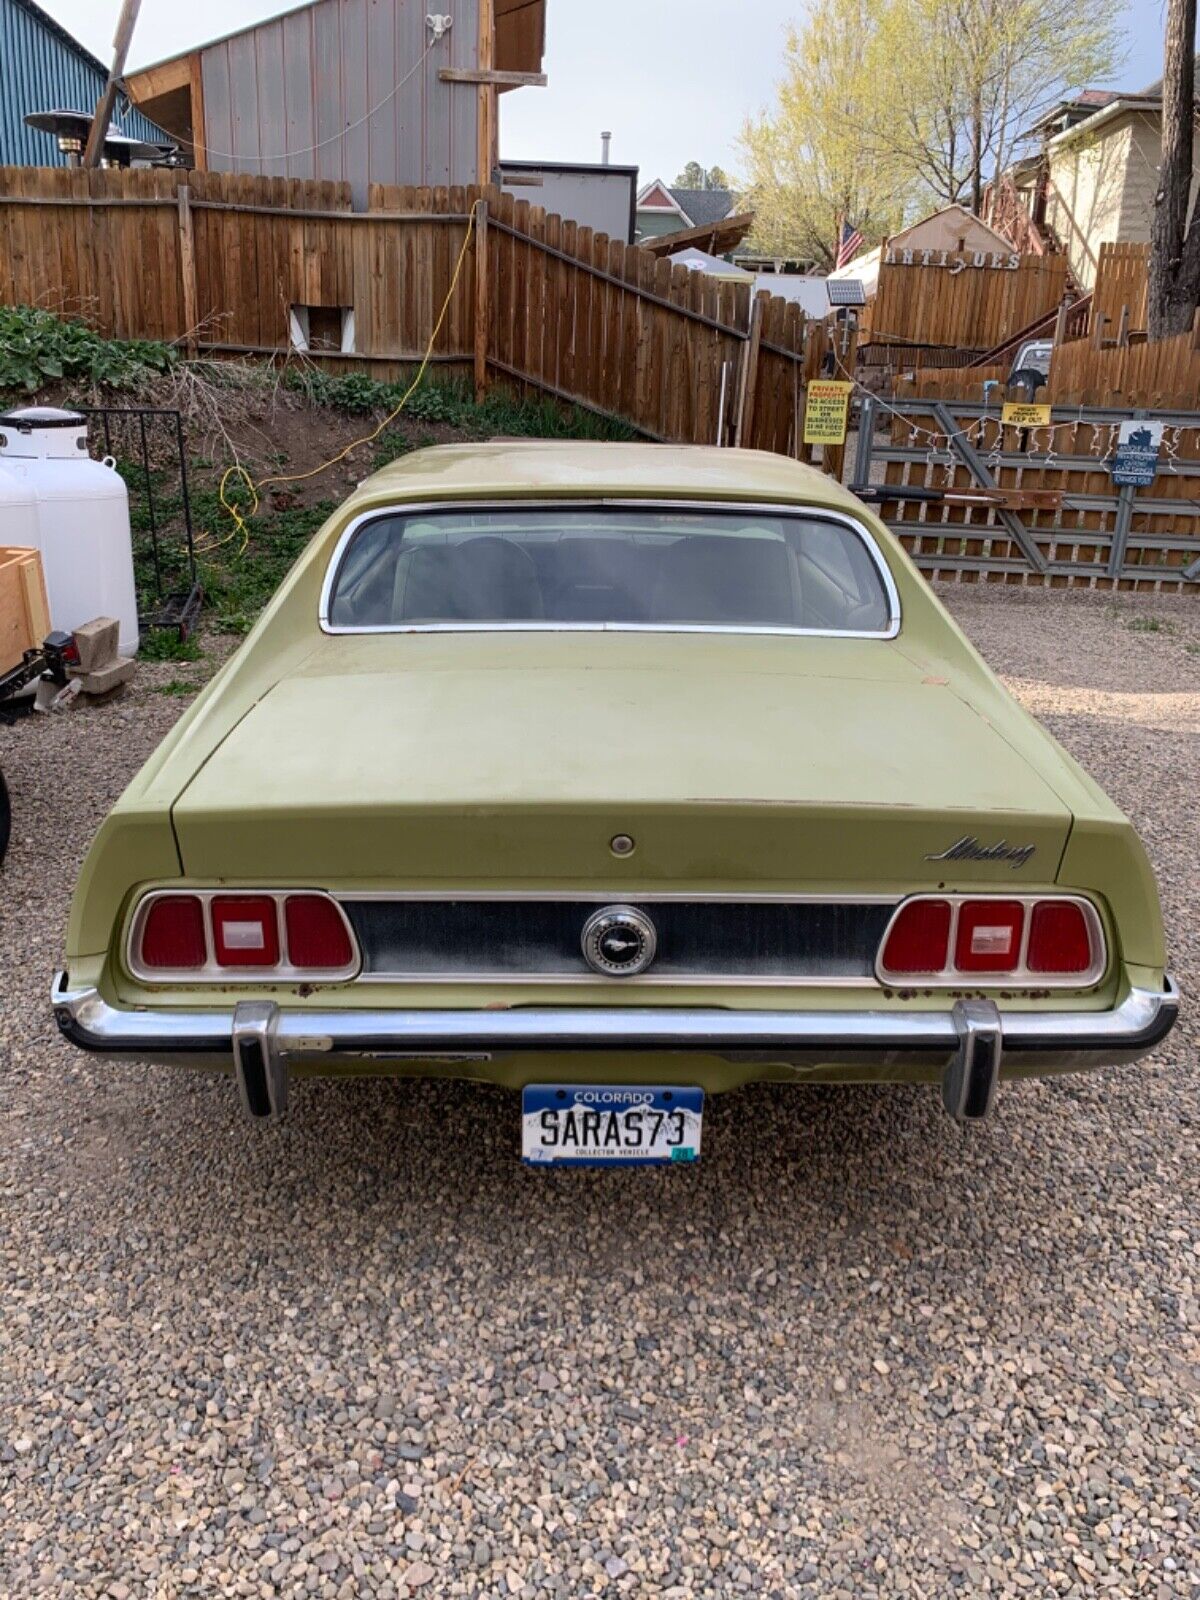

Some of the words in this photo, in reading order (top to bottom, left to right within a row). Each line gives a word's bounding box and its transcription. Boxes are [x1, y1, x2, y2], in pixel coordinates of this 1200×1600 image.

[574, 1091, 654, 1104] COLORADO
[541, 1110, 685, 1147] SARAS73
[619, 1148, 649, 1156] VEHICLE
